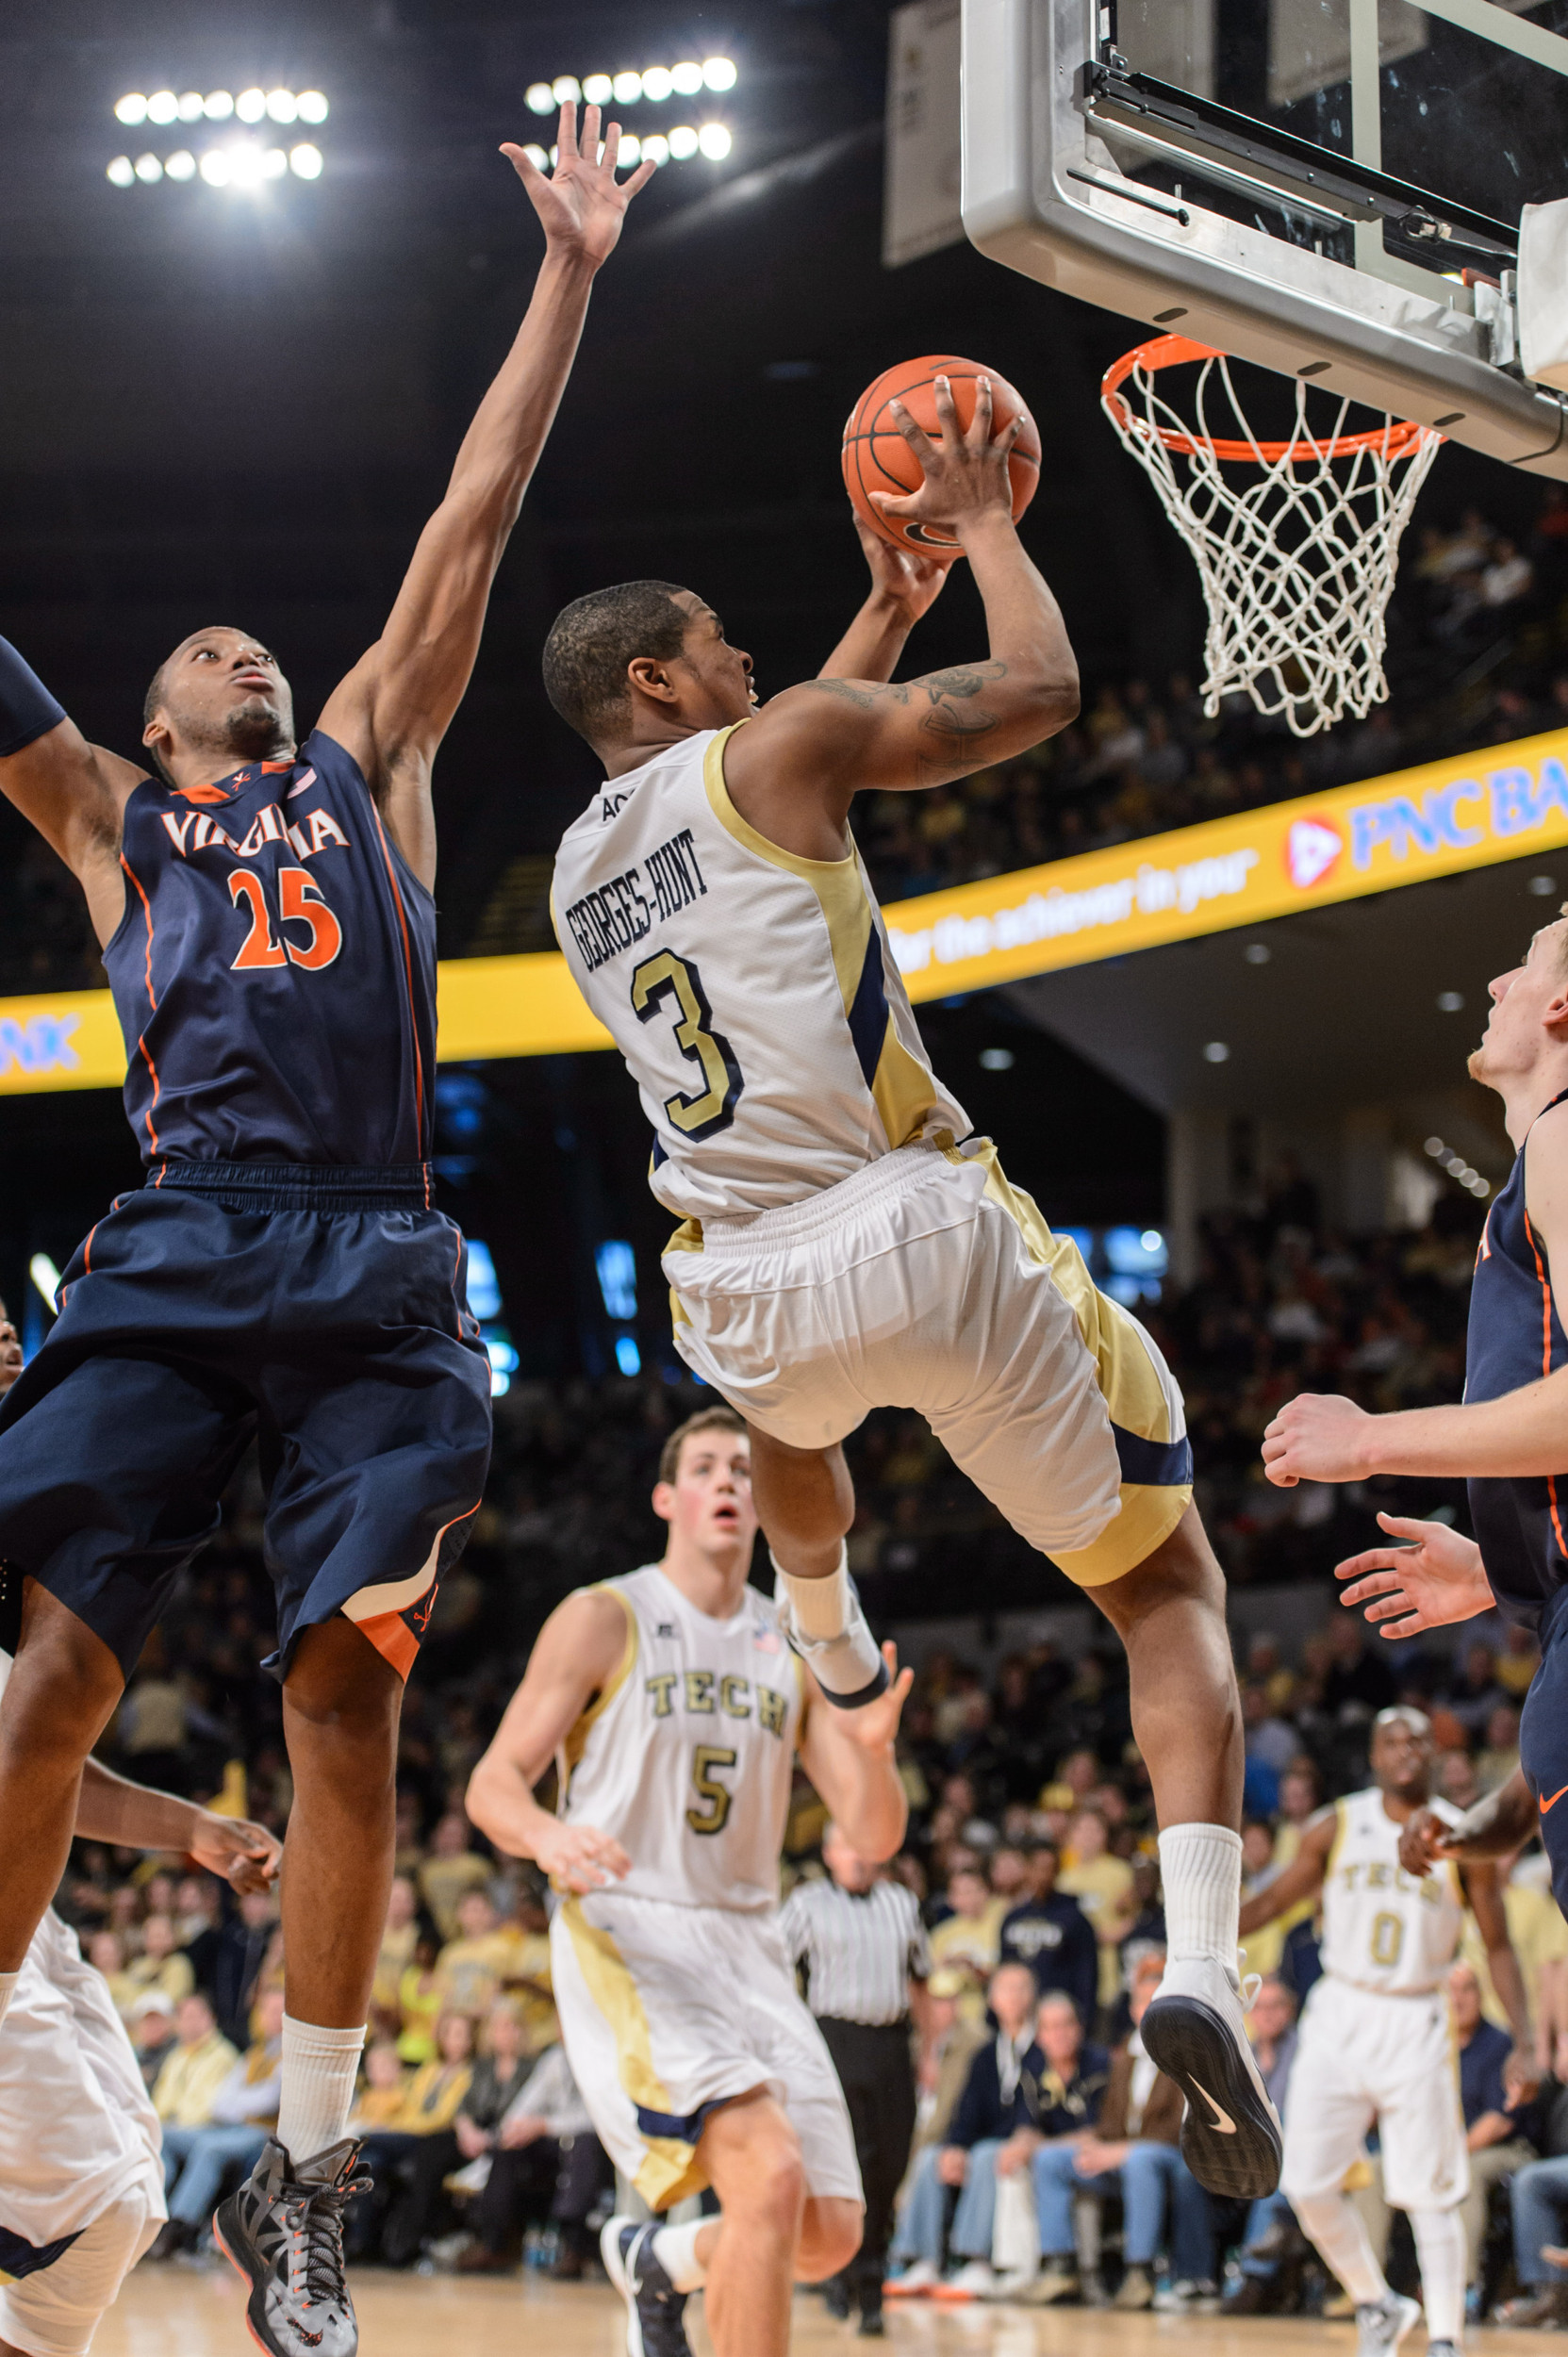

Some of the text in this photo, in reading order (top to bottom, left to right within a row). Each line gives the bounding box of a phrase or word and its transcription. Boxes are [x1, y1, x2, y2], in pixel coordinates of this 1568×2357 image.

[160, 802, 352, 862] VIGIIA
[602, 788, 635, 822] AC
[1348, 779, 1484, 872] PNC
[227, 866, 342, 971] 25
[566, 828, 708, 973] GEORGES-HUNT
[933, 914, 993, 964] the
[1135, 864, 1176, 914] in
[630, 948, 745, 1143] 3
[645, 1672, 788, 1740] TECH
[685, 1745, 737, 1836] 5
[1370, 1911, 1404, 1967] 0
